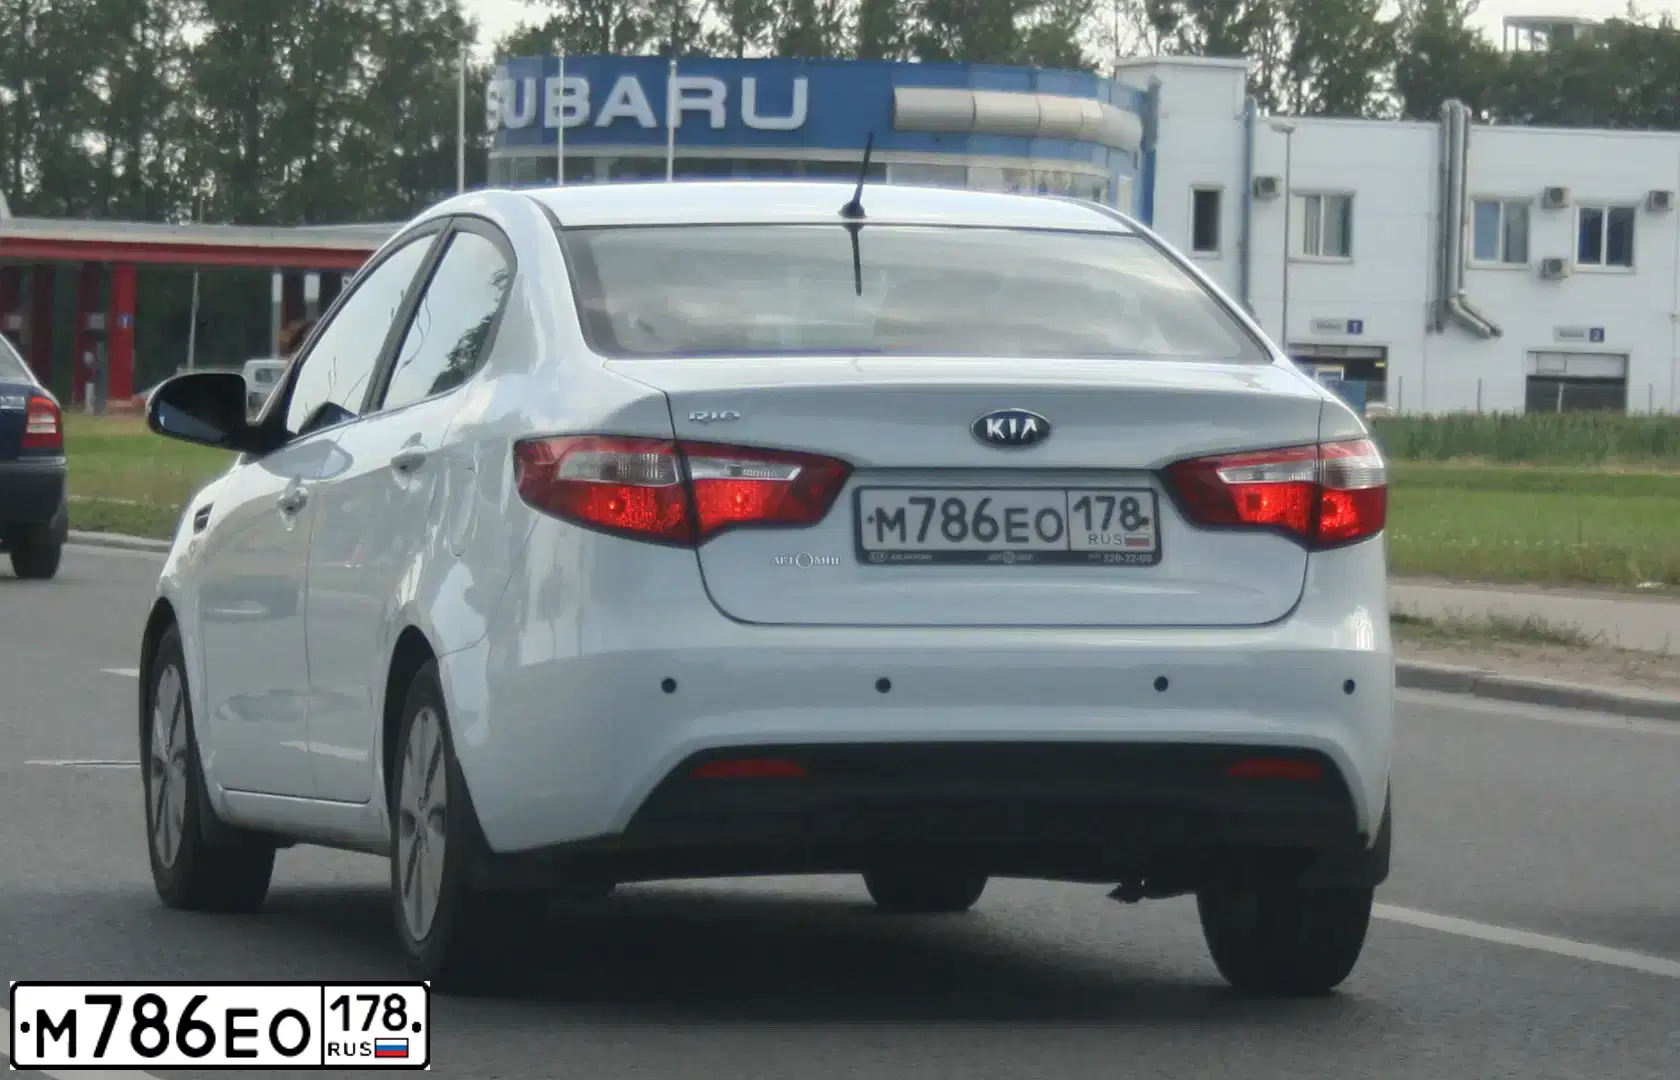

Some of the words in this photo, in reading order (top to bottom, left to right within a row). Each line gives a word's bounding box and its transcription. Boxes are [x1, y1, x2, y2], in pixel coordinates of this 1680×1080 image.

[486, 75, 808, 132] SUBARU
[688, 411, 741, 424] RIO
[986, 418, 1037, 439] KIA
[1072, 495, 1142, 532] 178
[1088, 533, 1123, 546] RUS
